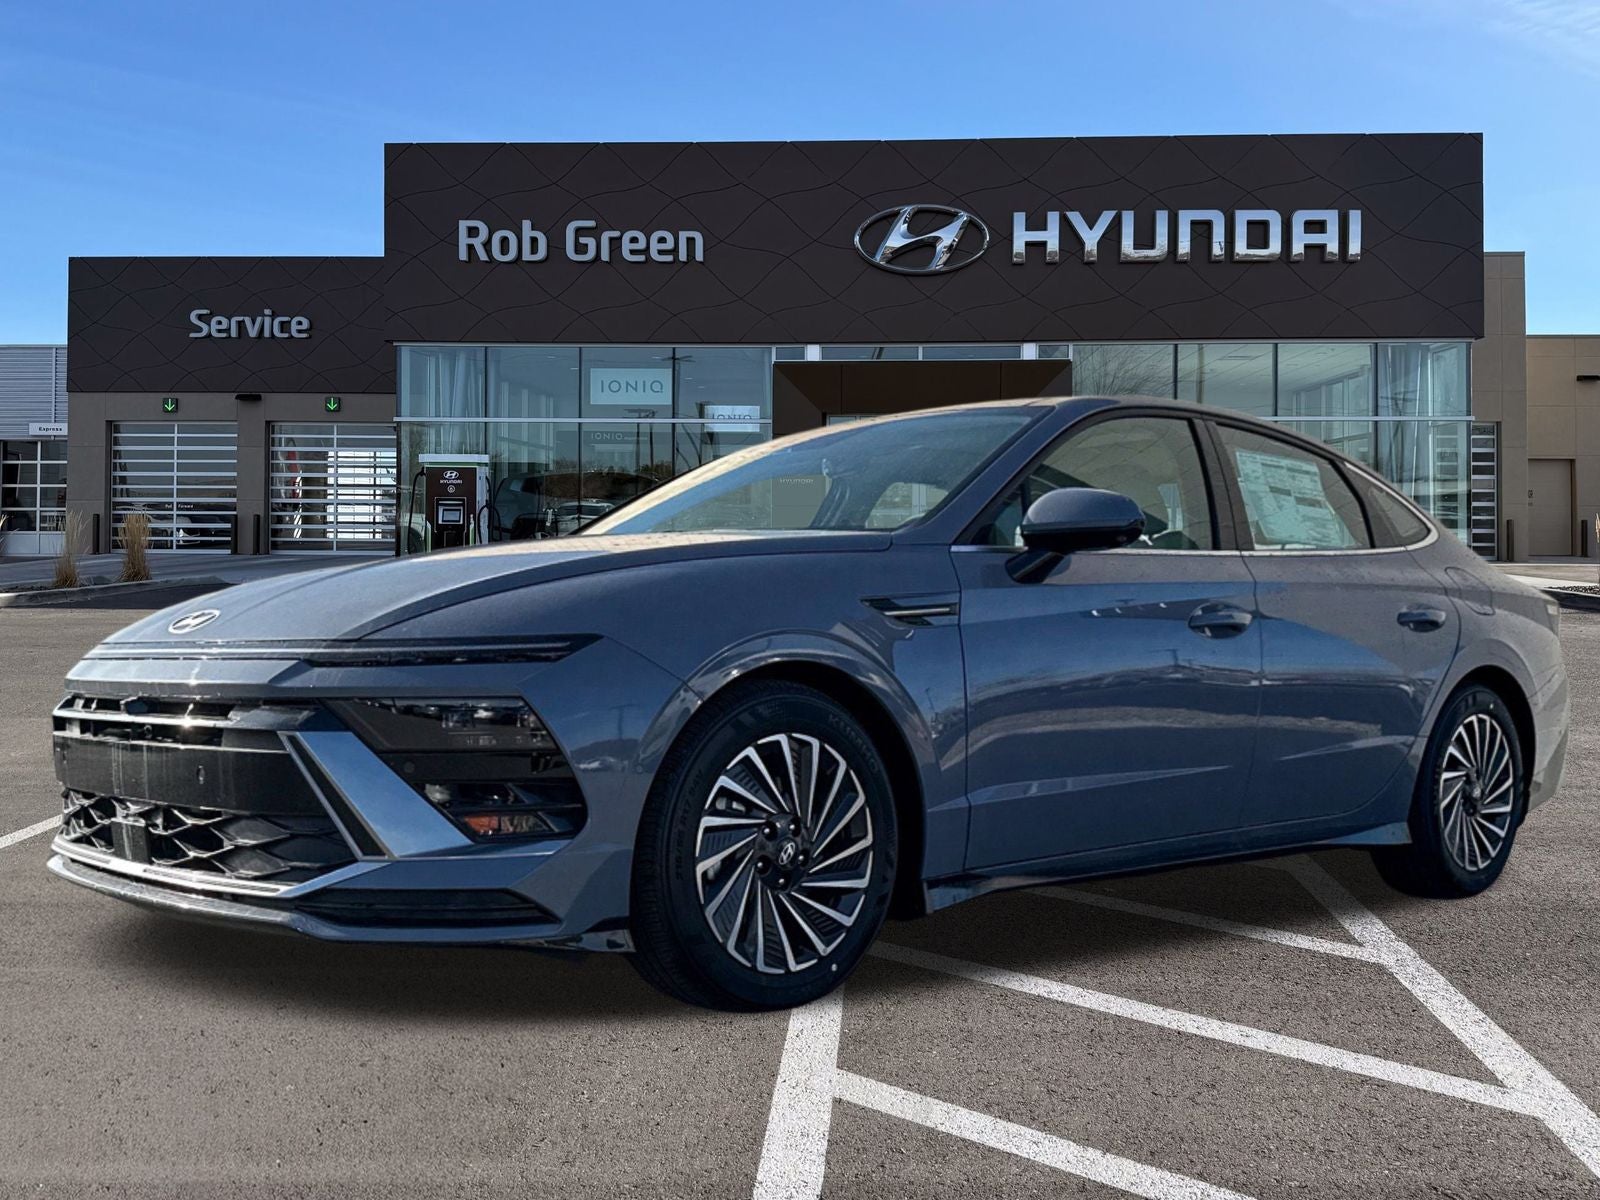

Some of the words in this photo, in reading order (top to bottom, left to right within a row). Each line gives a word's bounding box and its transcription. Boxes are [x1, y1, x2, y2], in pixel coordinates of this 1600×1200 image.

[458, 219, 548, 262] Rob
[565, 219, 704, 262] Green
[1012, 209, 1362, 264] HYUNDAI
[188, 308, 310, 338] Service
[600, 379, 664, 394] IONIQ
